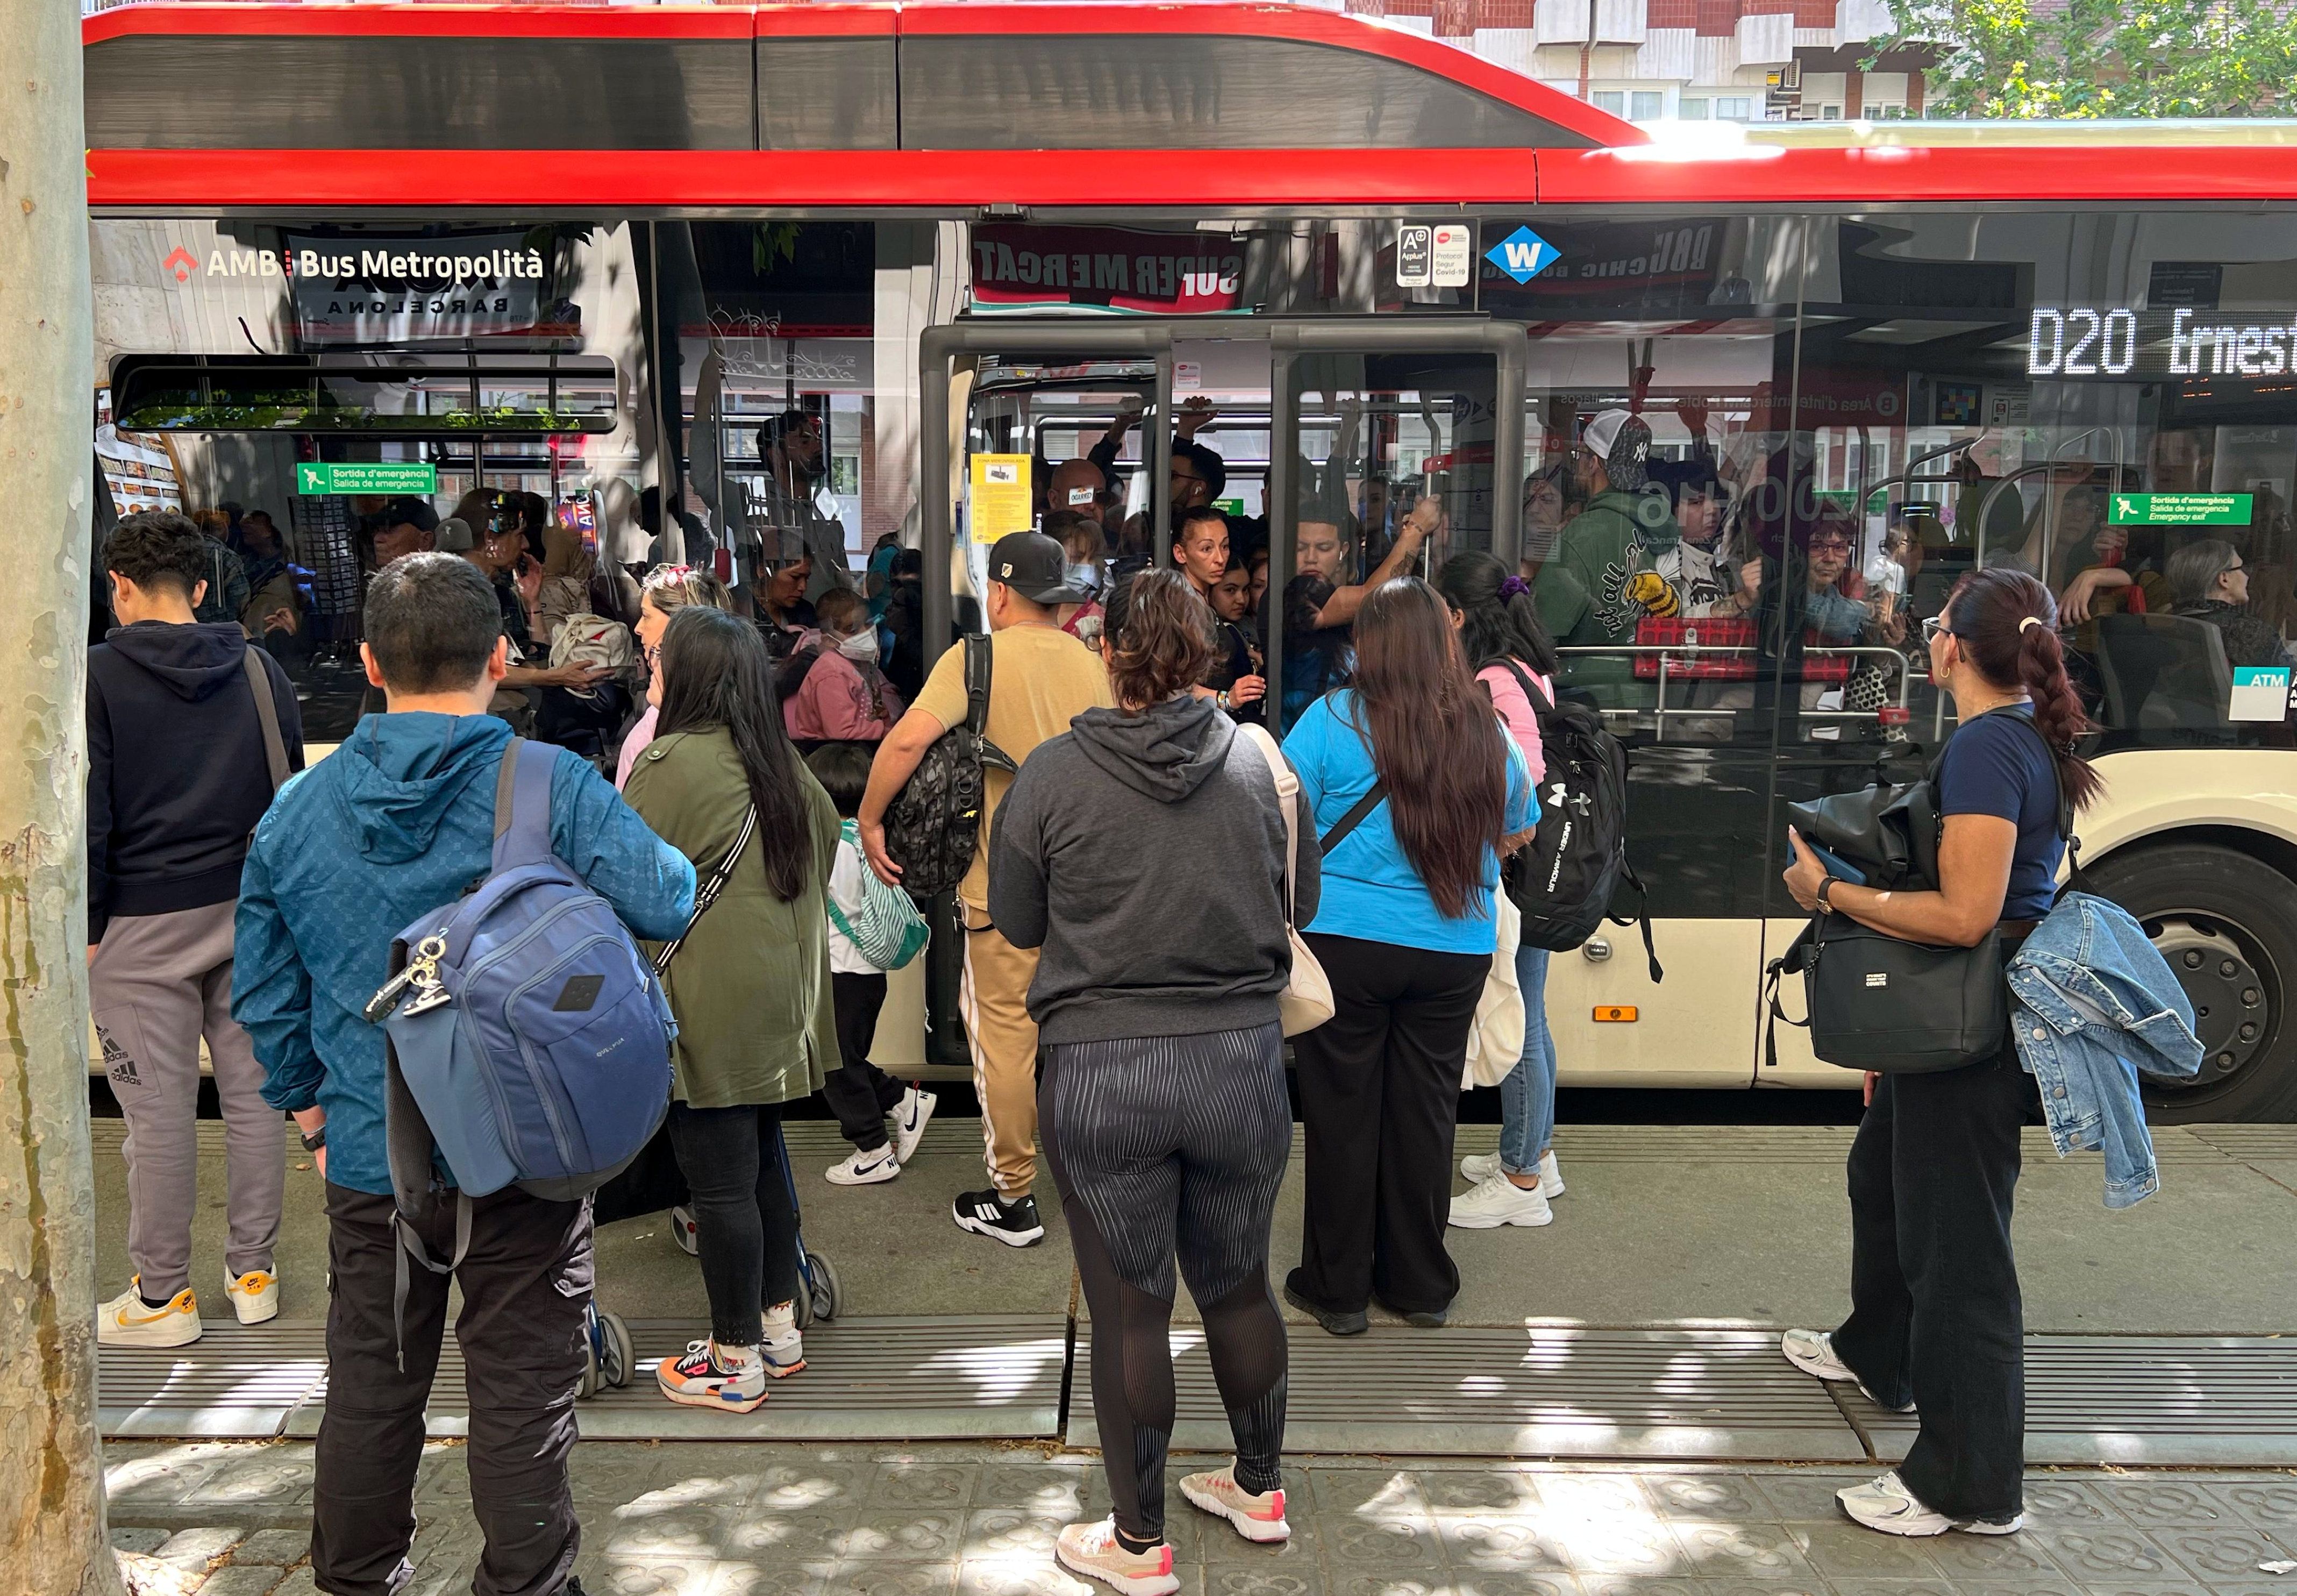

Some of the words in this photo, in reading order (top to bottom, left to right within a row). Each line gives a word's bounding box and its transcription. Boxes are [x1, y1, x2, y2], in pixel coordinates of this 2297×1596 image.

[1505, 243, 1542, 268] W
[207, 251, 278, 277] AMB
[301, 250, 355, 277] Bus
[362, 247, 543, 286] Metropolità
[2028, 308, 2136, 374] D20
[333, 469, 366, 478] Sortida
[368, 469, 430, 479] d'emergència
[333, 480, 362, 488] Salida
[362, 480, 373, 488] de
[375, 481, 424, 489] emergencia
[2181, 496, 2235, 505] d'emergència
[2186, 505, 2229, 514] emergencia
[2149, 512, 2191, 522] Emergency
[2250, 674, 2285, 687] ATM
[1558, 821, 1572, 852] UNDER
[1547, 852, 1561, 893] ARMOUR
[111, 1073, 142, 1085] adidas
